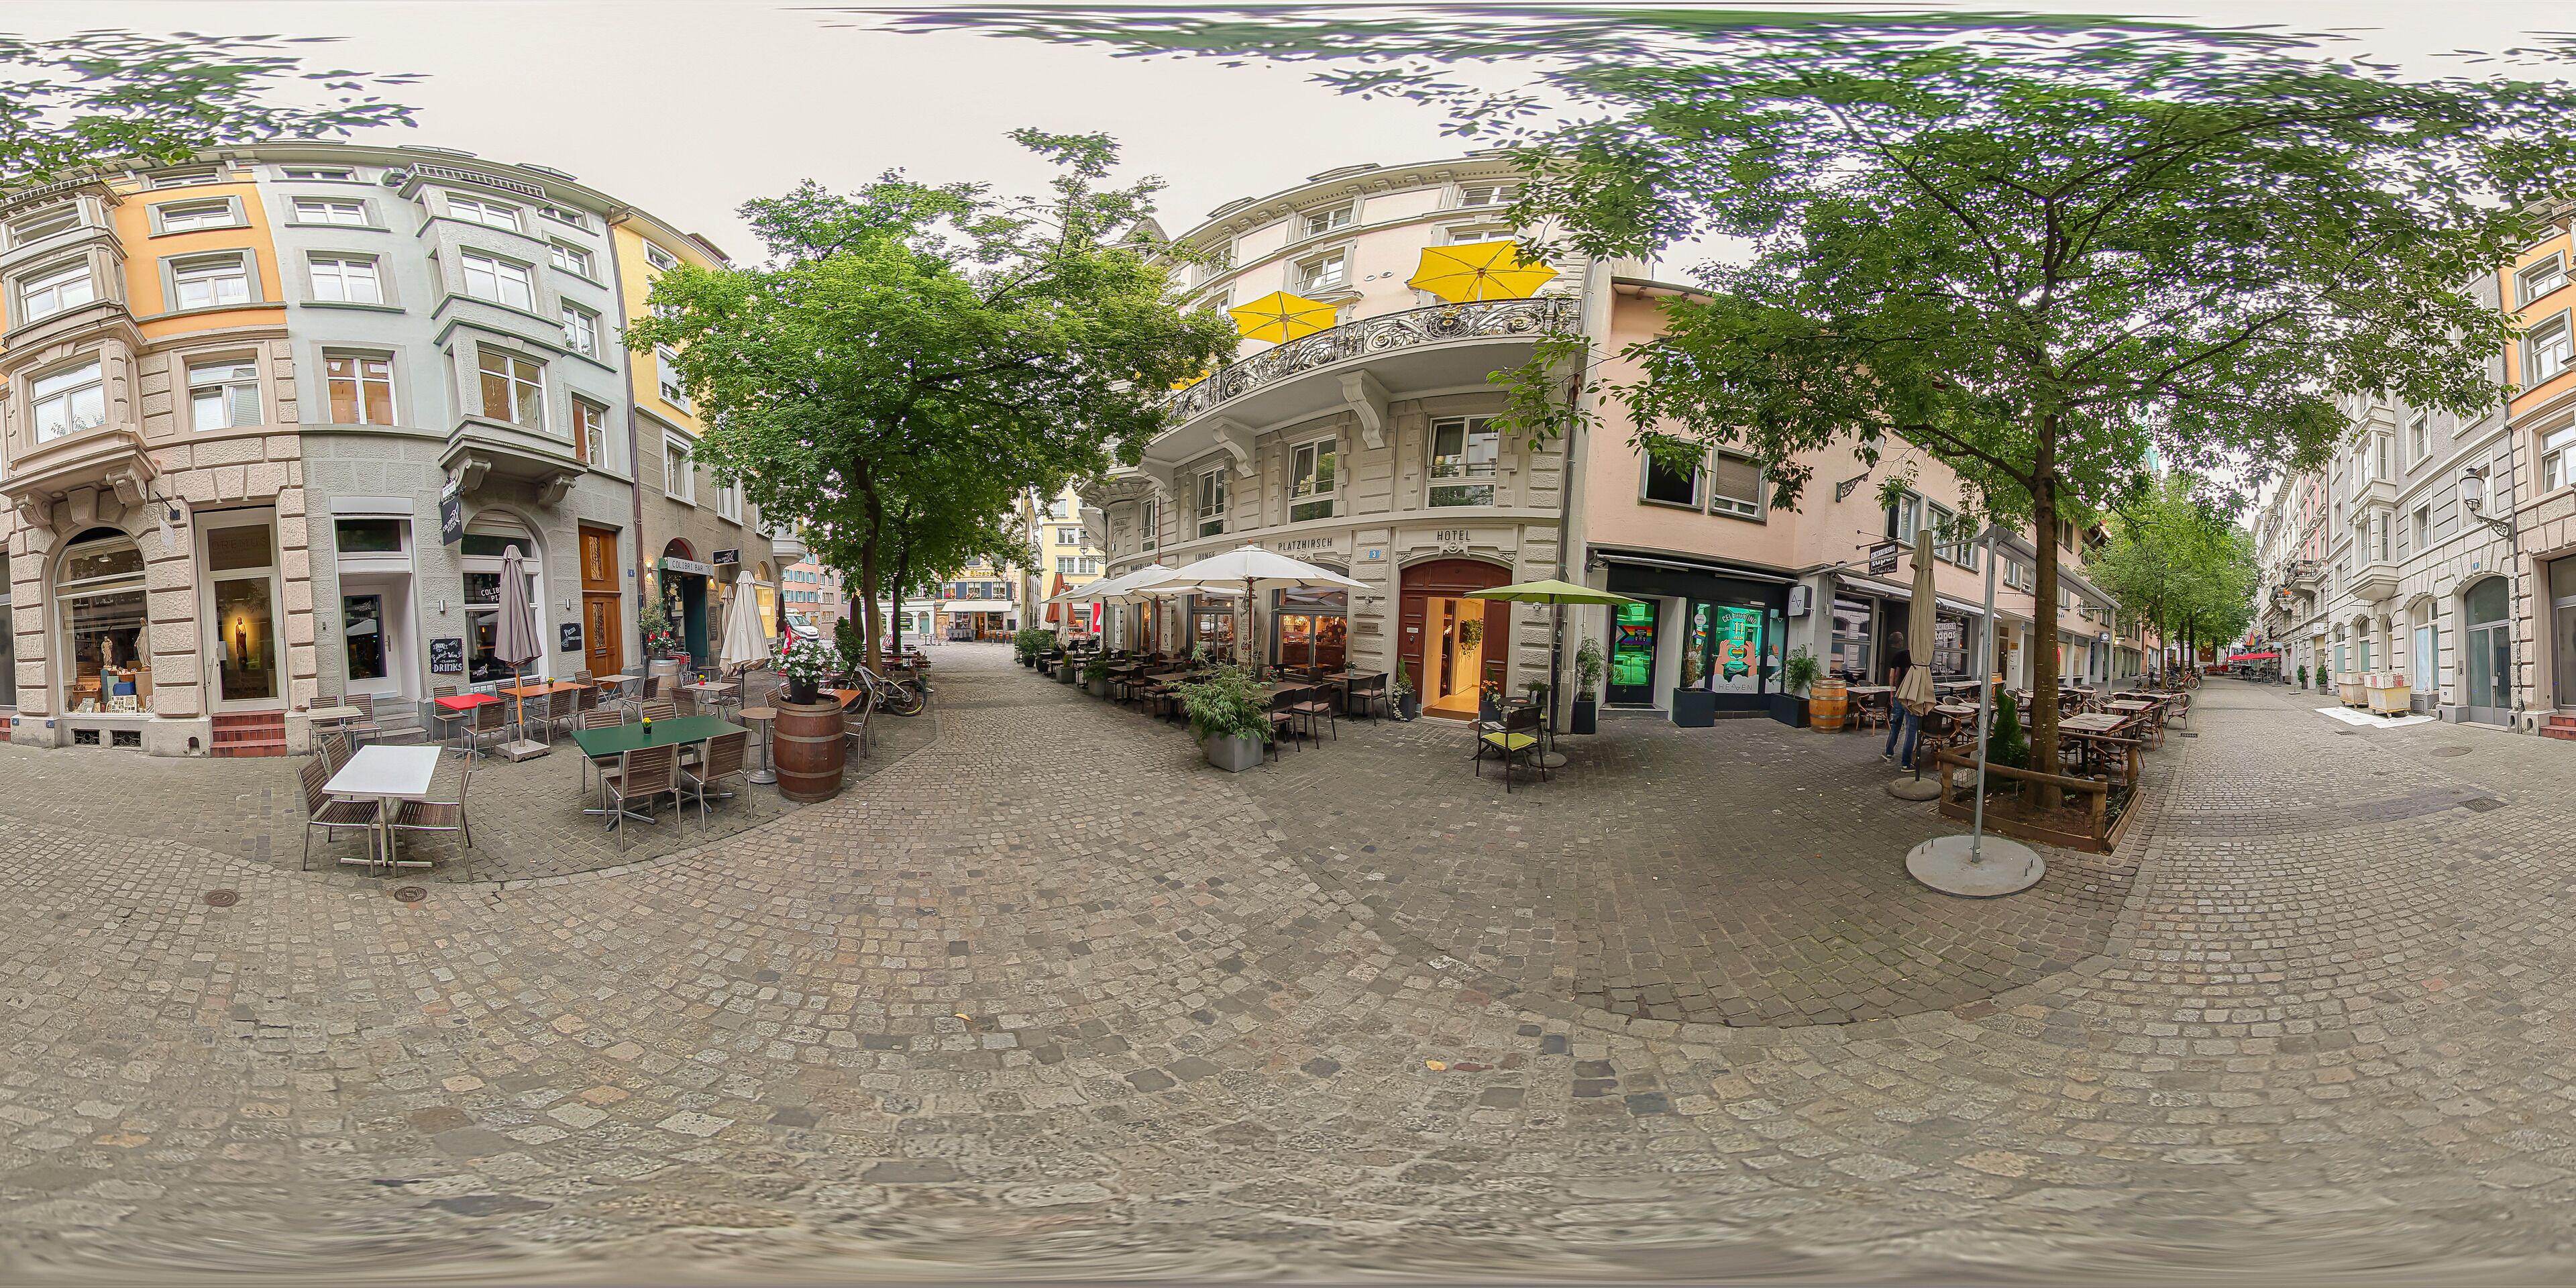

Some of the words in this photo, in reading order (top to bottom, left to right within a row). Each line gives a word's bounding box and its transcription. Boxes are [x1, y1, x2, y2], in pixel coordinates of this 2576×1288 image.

[443, 516, 455, 532] COLIBRI
[447, 521, 457, 534] PIZZA
[1437, 530, 1471, 541] HOTEL
[211, 537, 268, 550] OREMUS
[1278, 537, 1333, 551] PLATZHIRSCH
[1195, 551, 1216, 561] LOUNGE
[1872, 546, 1894, 557] AMIGOS
[672, 560, 693, 571] COLIBRI
[695, 564, 704, 572] BAR
[1735, 622, 1743, 635] 11
[1935, 631, 1955, 642] tapas
[433, 663, 462, 672] DRINKS
[1719, 683, 1753, 691] HEAVEN
